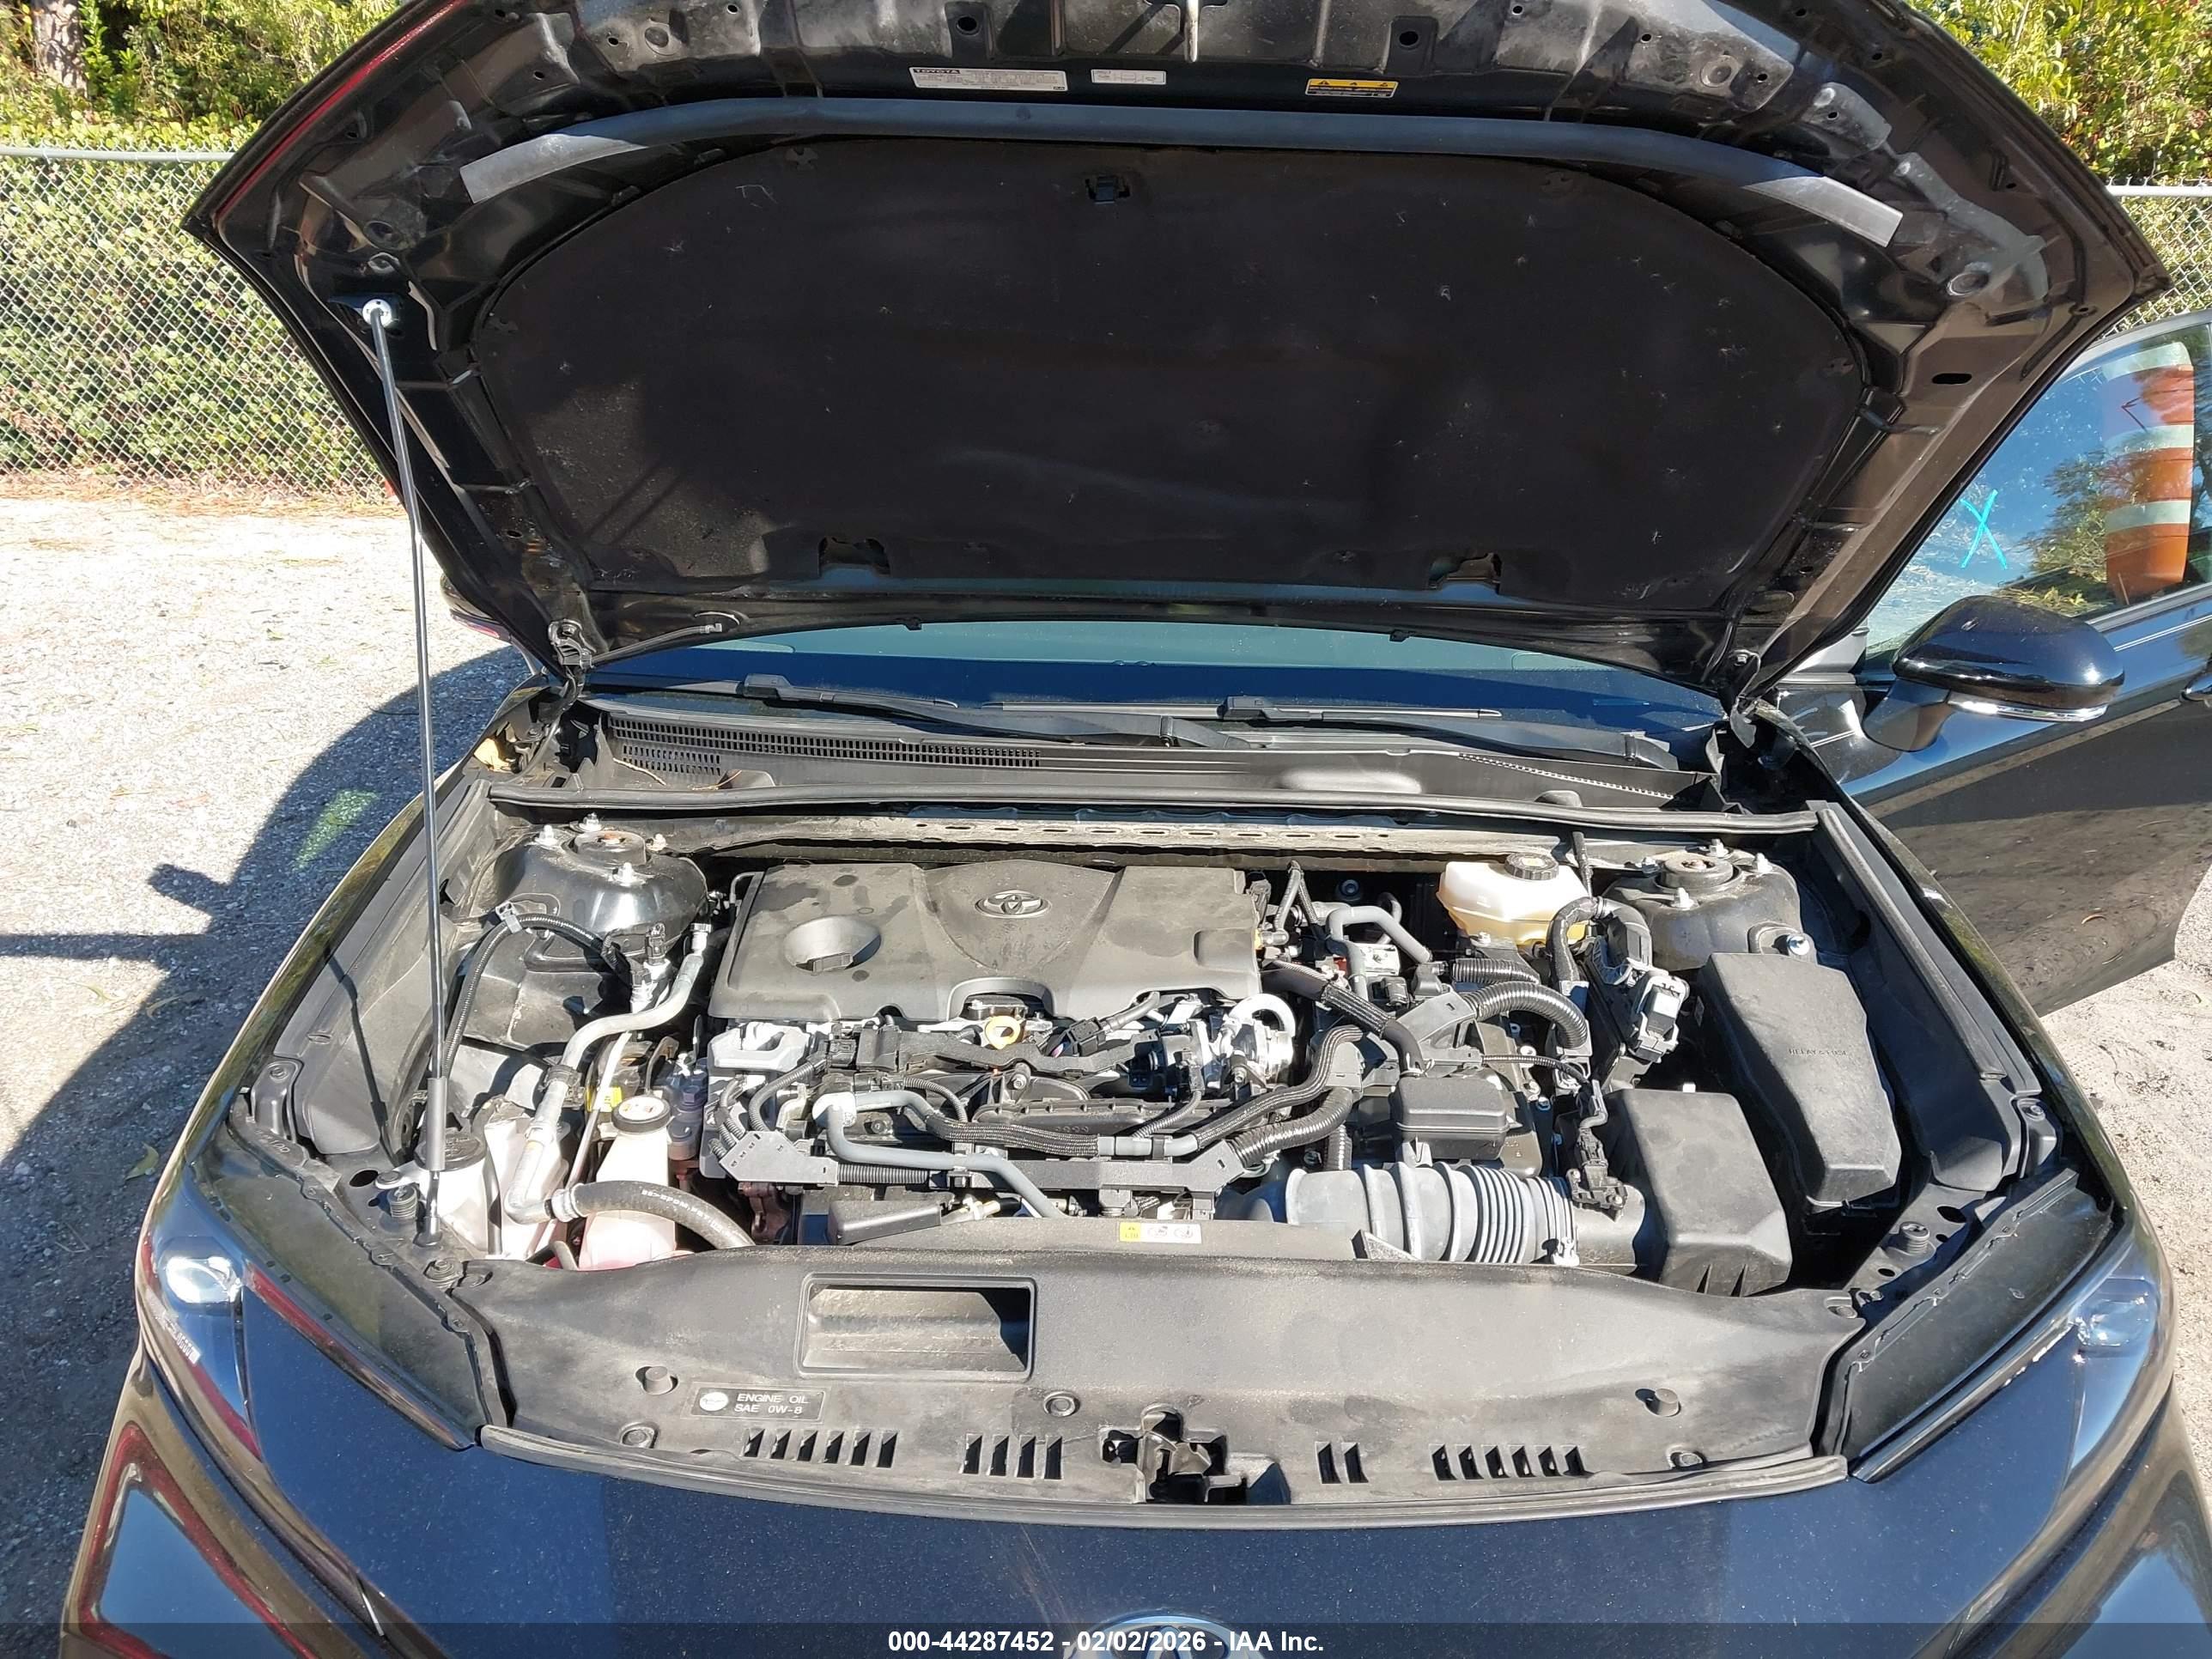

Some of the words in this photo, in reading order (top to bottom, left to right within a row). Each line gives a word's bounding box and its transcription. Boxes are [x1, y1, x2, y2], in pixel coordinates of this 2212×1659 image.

[737, 1393, 783, 1403] ENGINE
[788, 1395, 809, 1404] OIL
[734, 1404, 759, 1413] SAE
